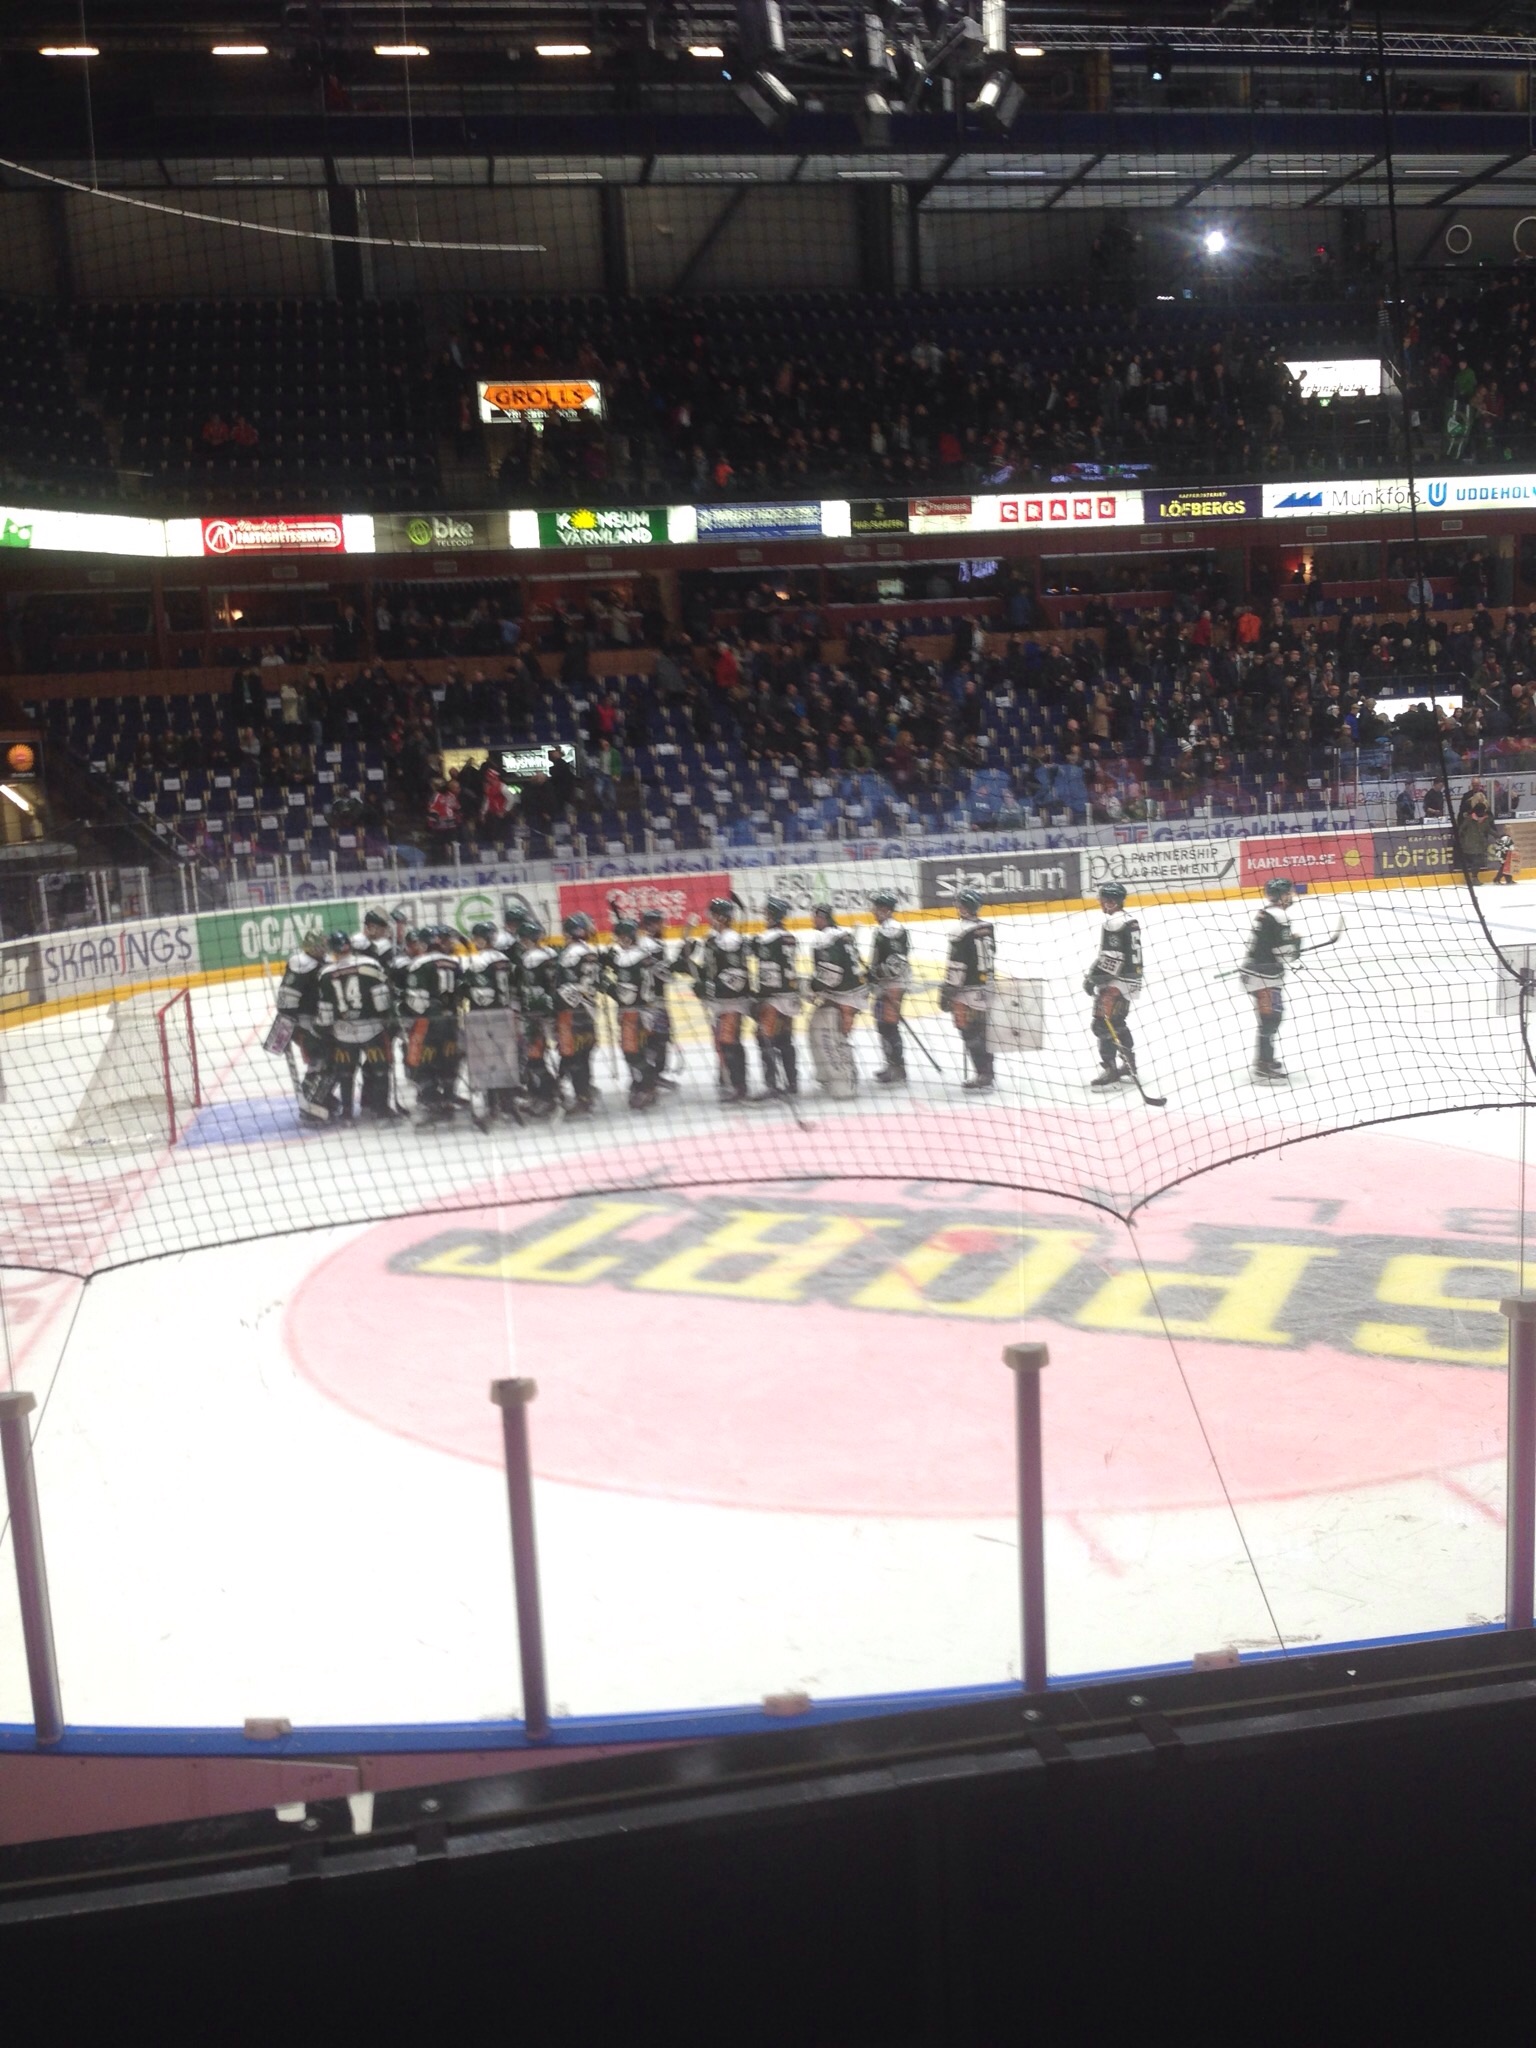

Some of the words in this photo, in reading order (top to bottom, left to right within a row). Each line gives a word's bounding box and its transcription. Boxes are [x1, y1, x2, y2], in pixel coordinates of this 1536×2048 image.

[495, 387, 584, 405] GROLLS
[1456, 486, 1536, 501] UDDEHOL
[1160, 500, 1247, 518] LÖFBERGS
[432, 516, 474, 539] bke
[1131, 848, 1219, 863] PARTNERSHIP
[1247, 853, 1336, 869] KARLSTAD.SE
[1382, 846, 1503, 869] LÖFBES
[1131, 862, 1219, 877] AGREEMENT
[935, 863, 1067, 897] stadium
[43, 927, 193, 984] SKARINGS
[0, 950, 30, 996] ar
[331, 974, 363, 1013] 14
